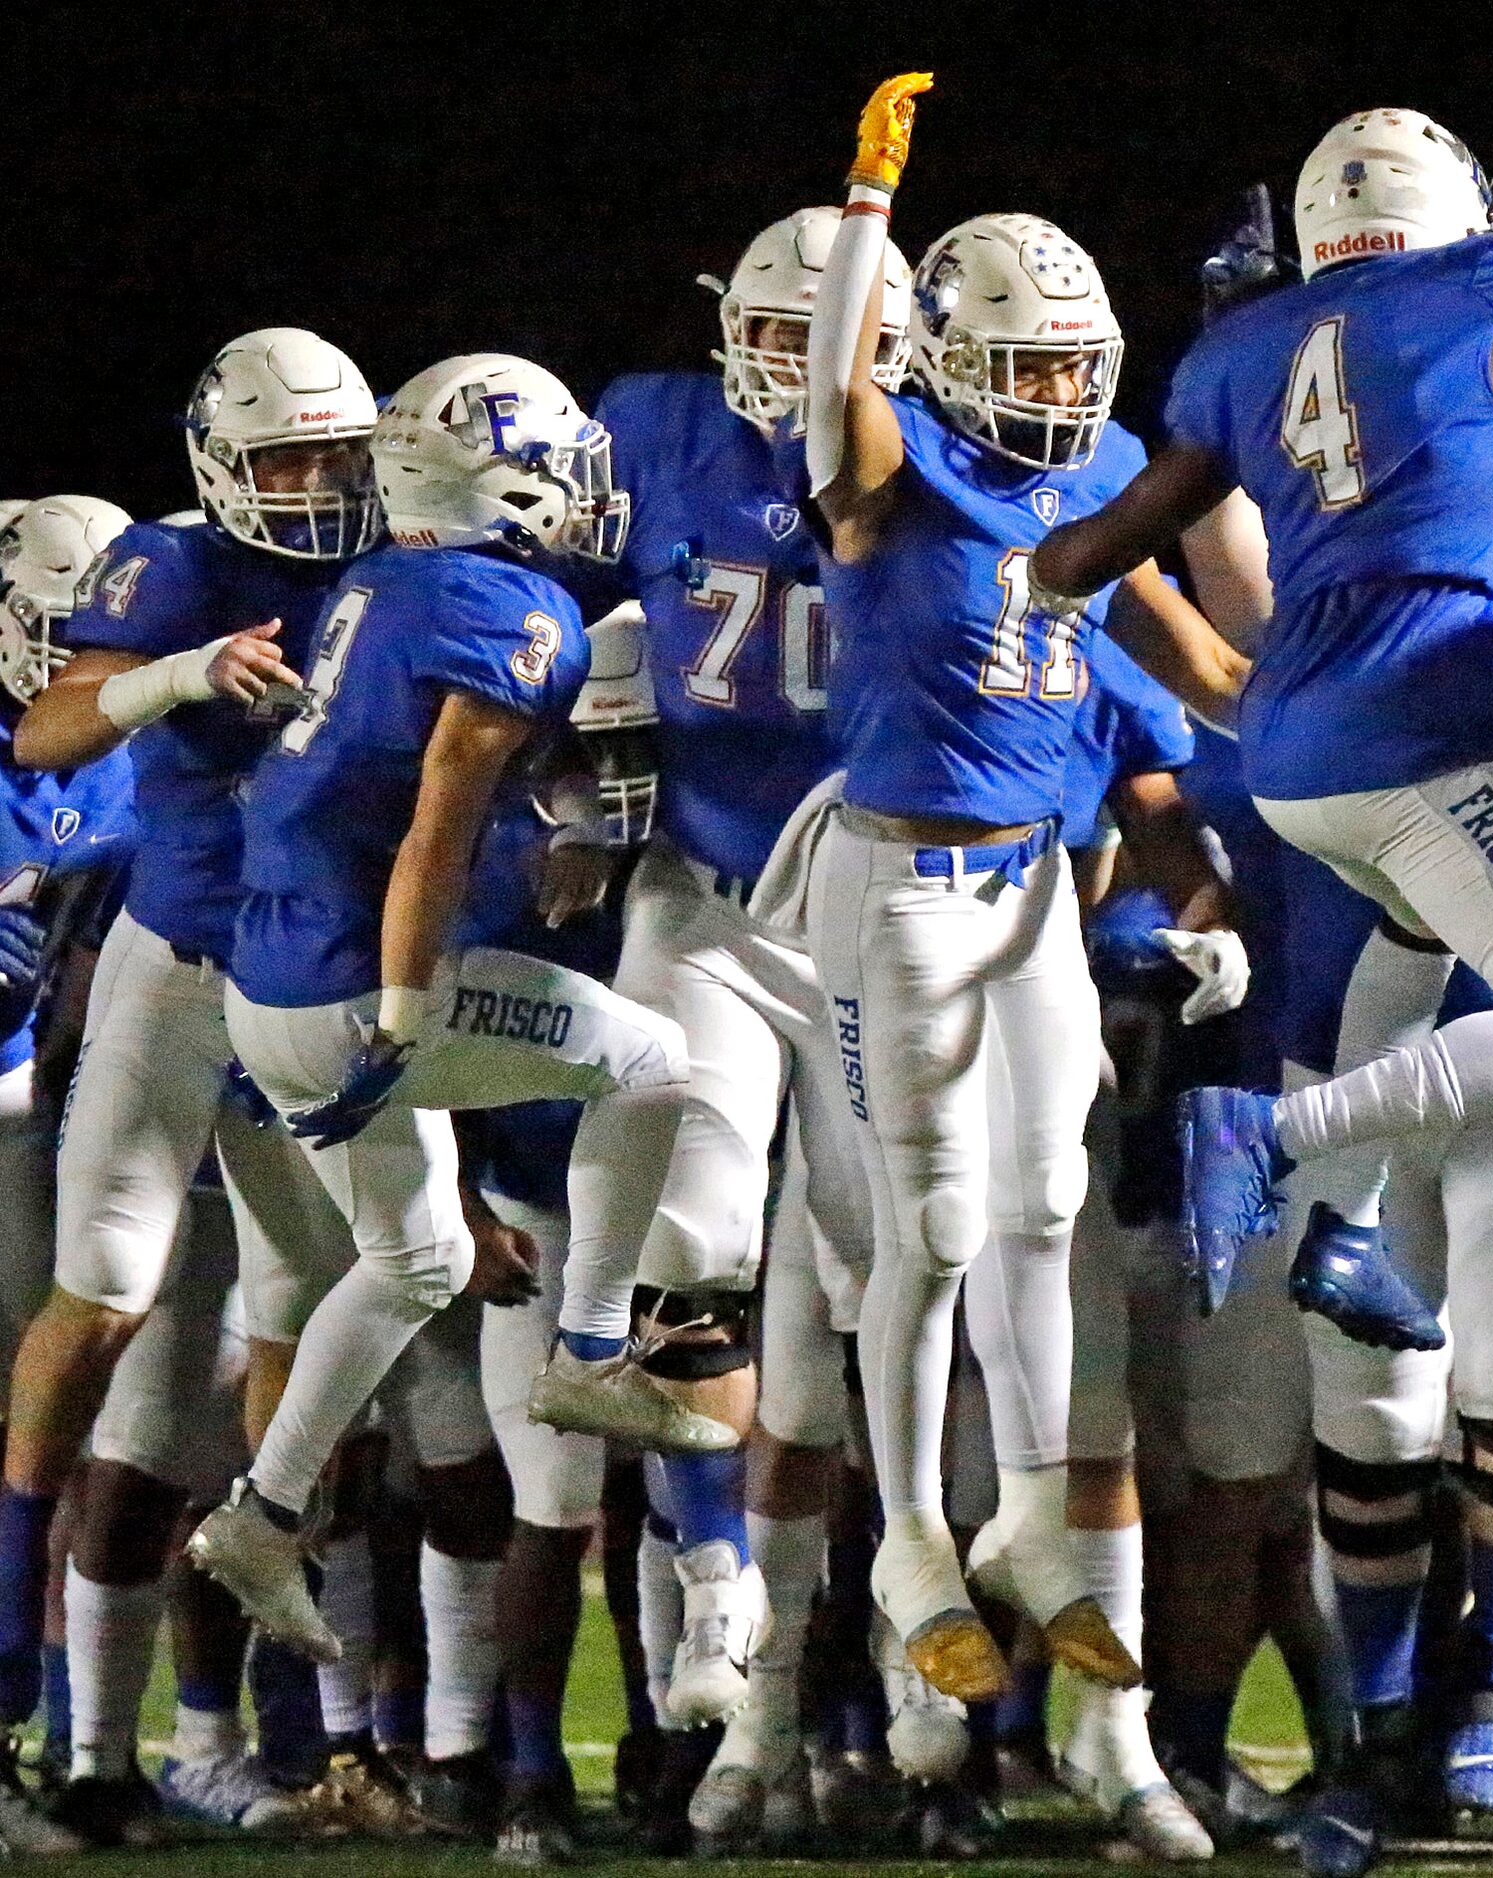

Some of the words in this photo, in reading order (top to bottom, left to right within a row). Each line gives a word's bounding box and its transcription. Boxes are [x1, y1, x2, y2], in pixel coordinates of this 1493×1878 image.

[1314, 230, 1405, 263] Riddell
[477, 391, 520, 456] F
[1281, 315, 1366, 512] 4
[510, 609, 563, 685] 3
[446, 988, 573, 1048] FRISCO
[833, 995, 869, 1122] FRISCO
